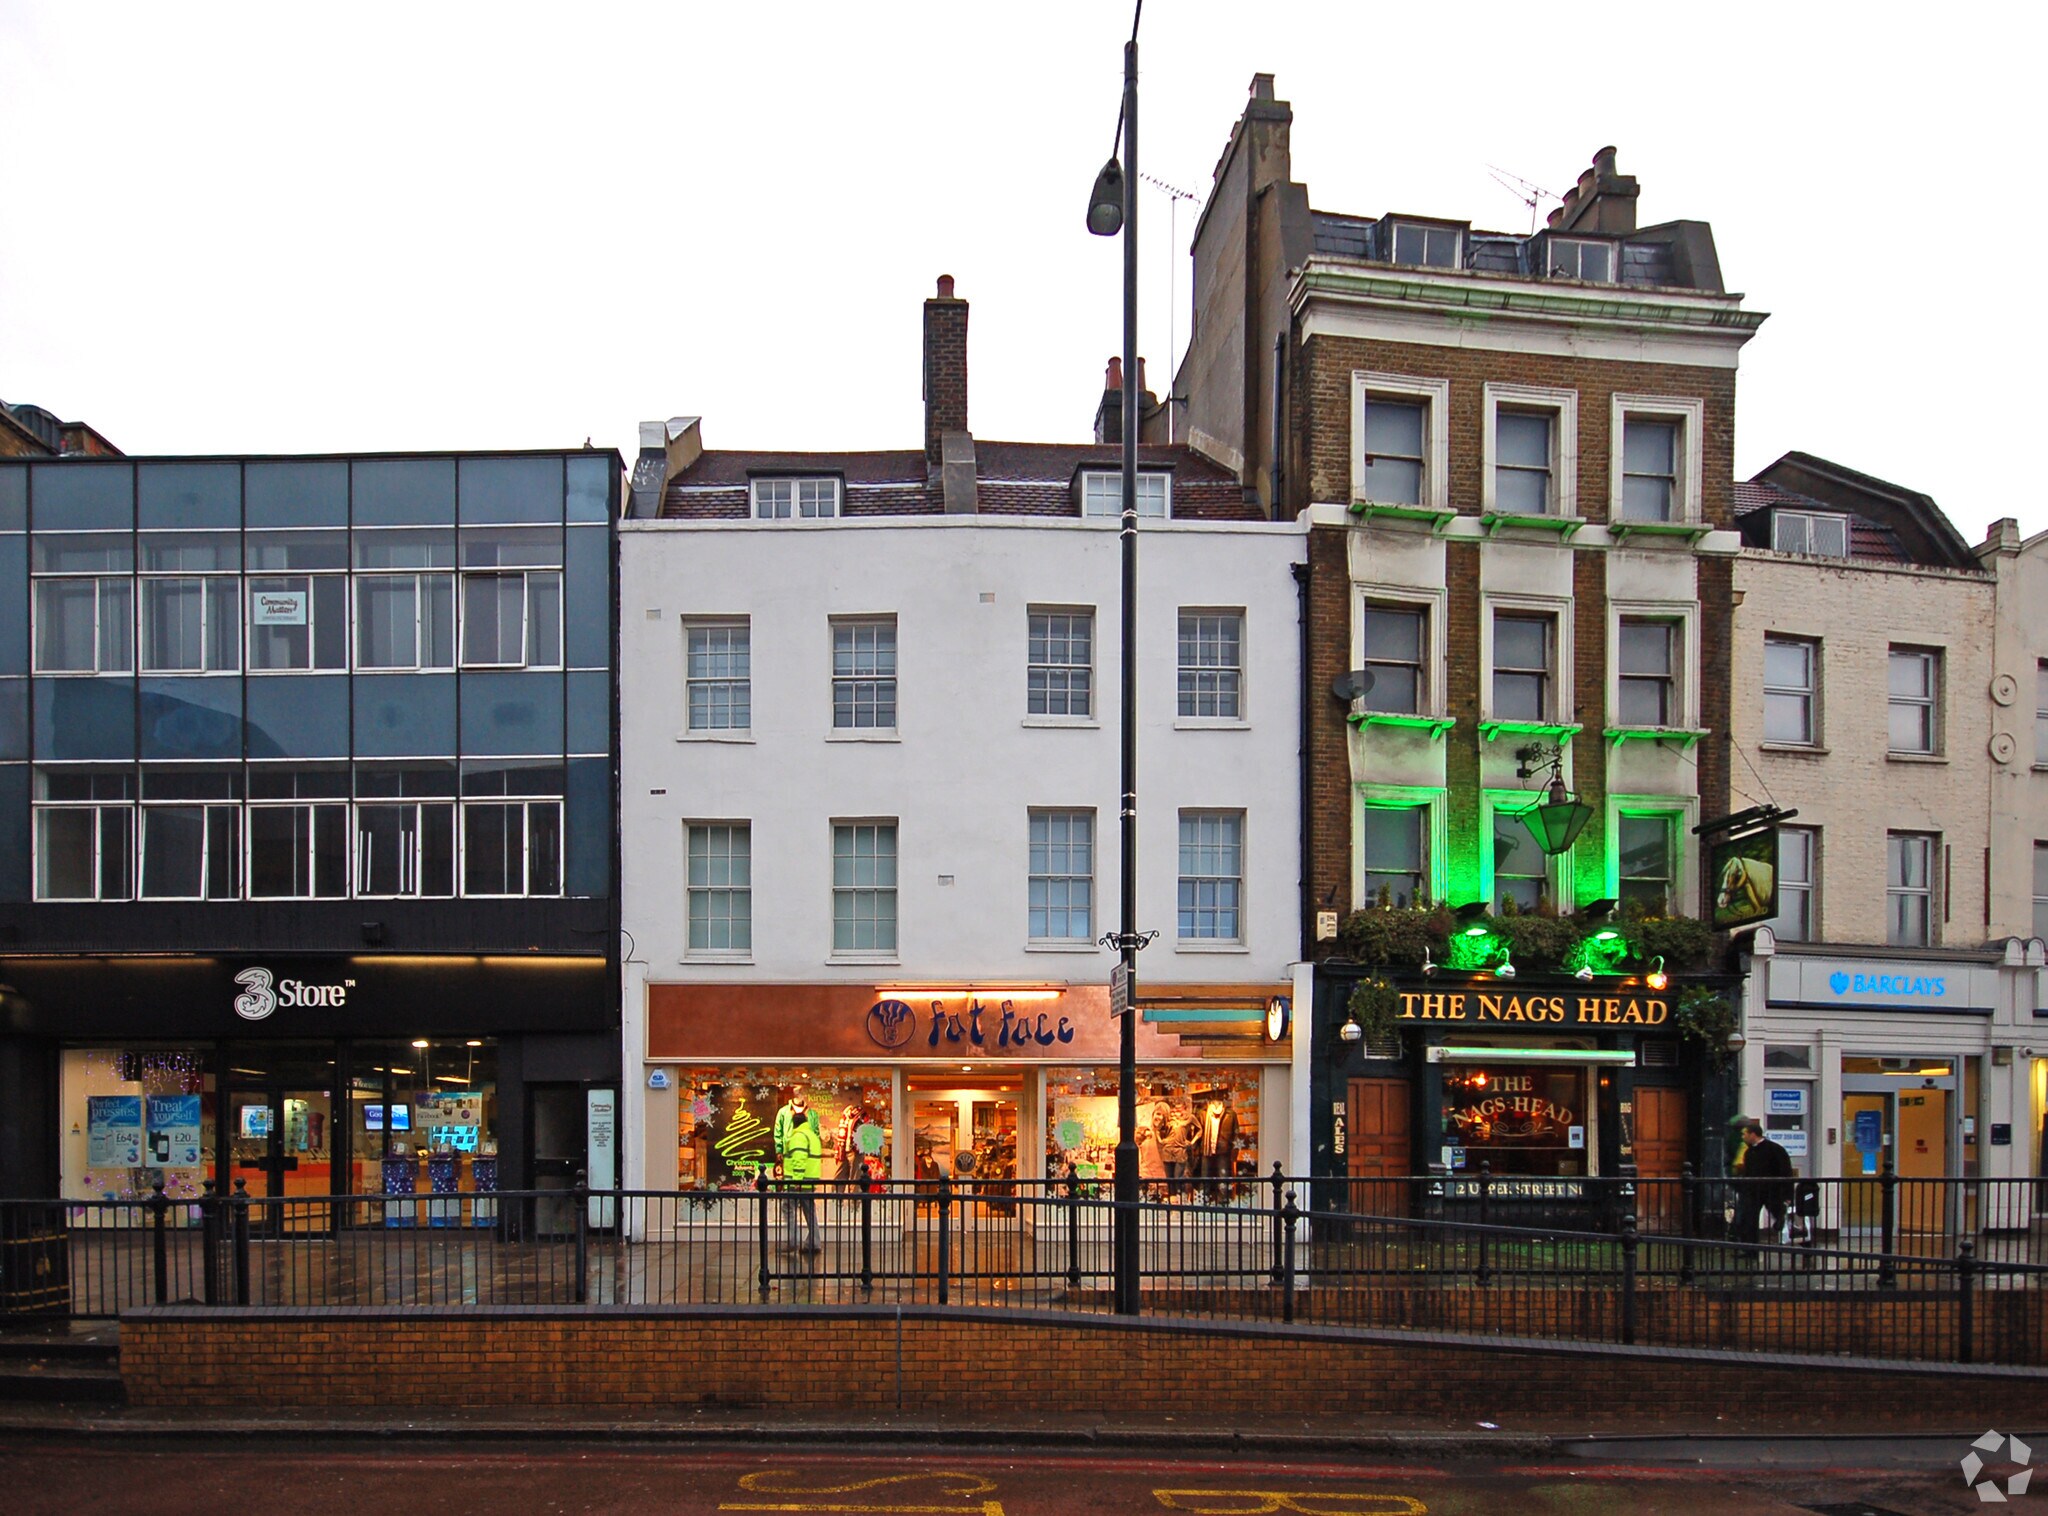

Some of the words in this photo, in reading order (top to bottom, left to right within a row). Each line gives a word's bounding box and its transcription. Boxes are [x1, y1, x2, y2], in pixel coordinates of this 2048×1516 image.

[234, 966, 277, 1020] 3
[278, 979, 346, 1007] Store
[1853, 974, 1946, 997] BARCLAYS
[1398, 993, 1466, 1019] THE
[1477, 994, 1565, 1022] NAGS
[1576, 998, 1668, 1024] HEAD
[1489, 1076, 1533, 1092] THE
[152, 1100, 182, 1112] Treat
[1452, 1096, 1506, 1128] NAGS
[1513, 1096, 1573, 1125] HEAD
[1335, 1117, 1345, 1154] ALES
[1468, 1183, 1513, 1195] UPER
